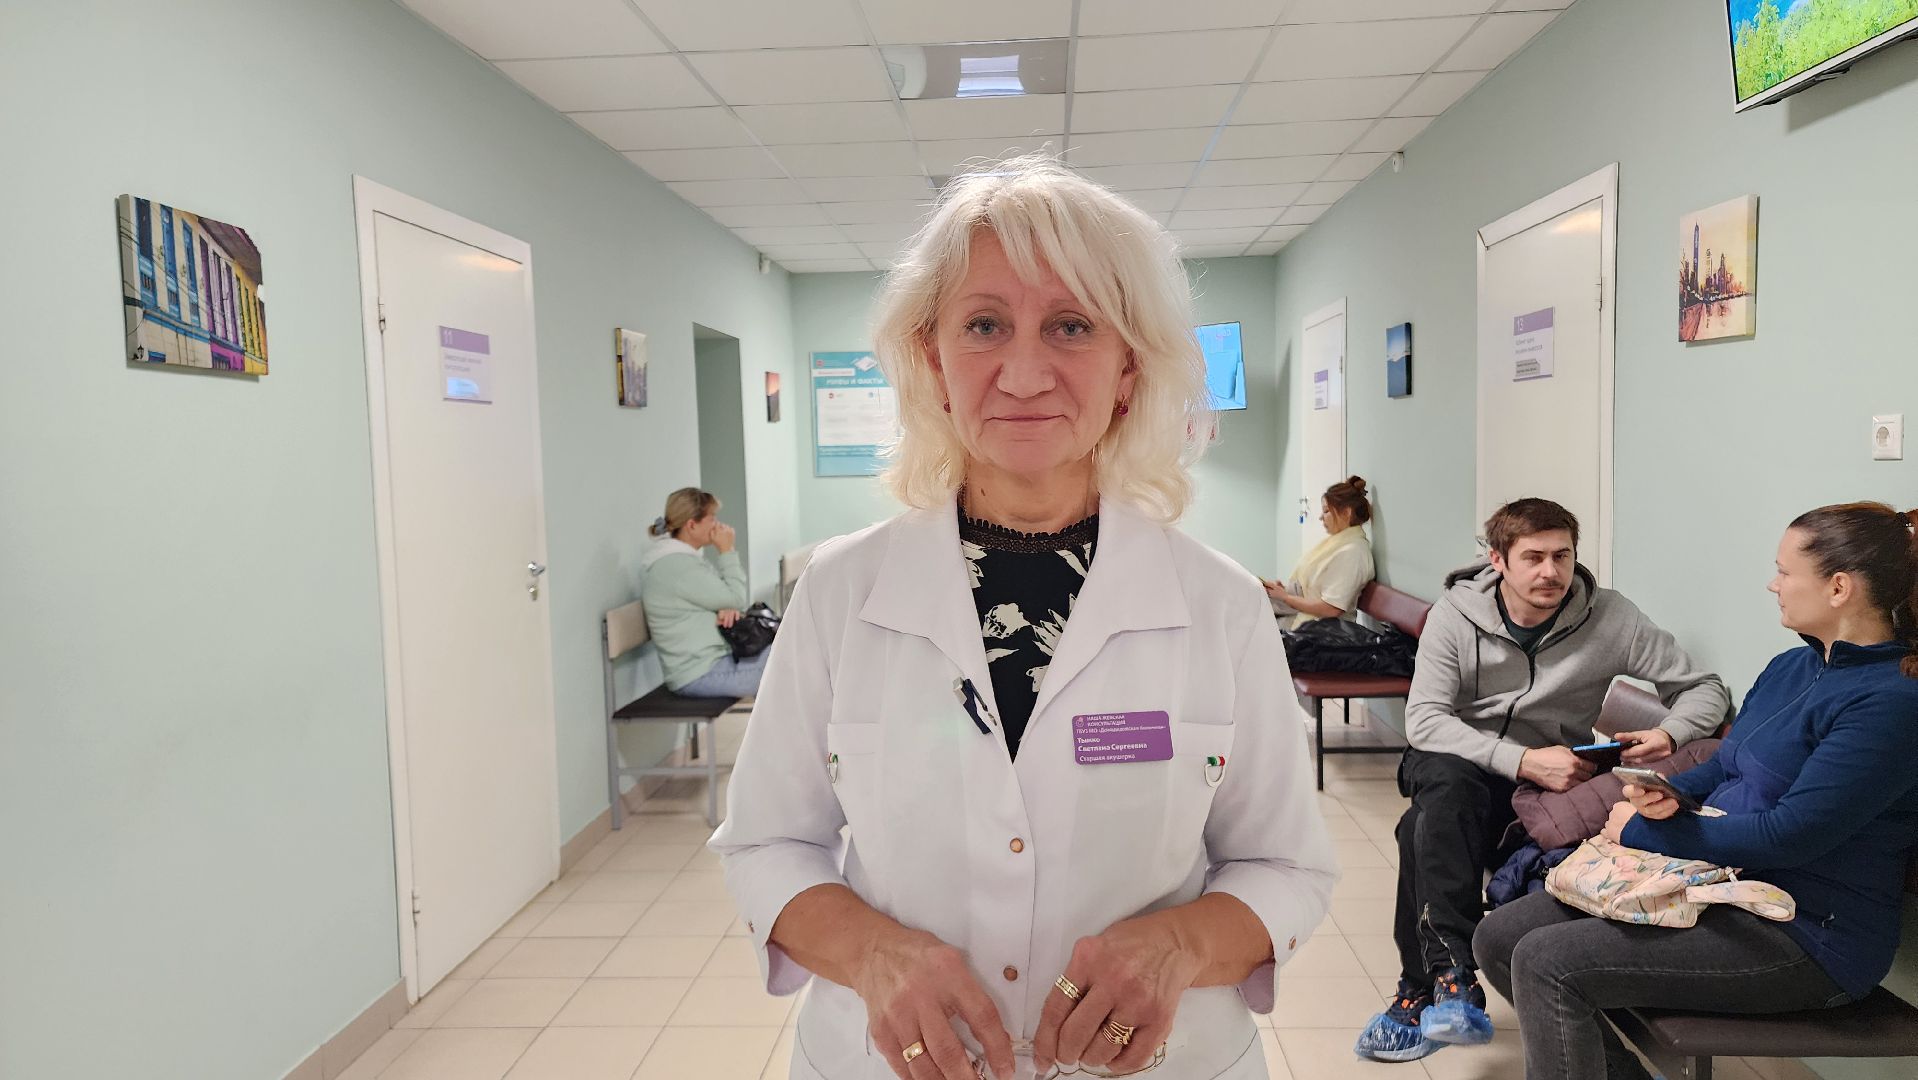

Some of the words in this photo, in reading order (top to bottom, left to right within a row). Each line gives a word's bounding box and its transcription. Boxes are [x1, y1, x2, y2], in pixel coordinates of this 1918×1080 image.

[1111, 743, 1148, 751] Сергеевна
[1079, 755, 1106, 763] Старшая
[1106, 753, 1136, 761] акушерка
